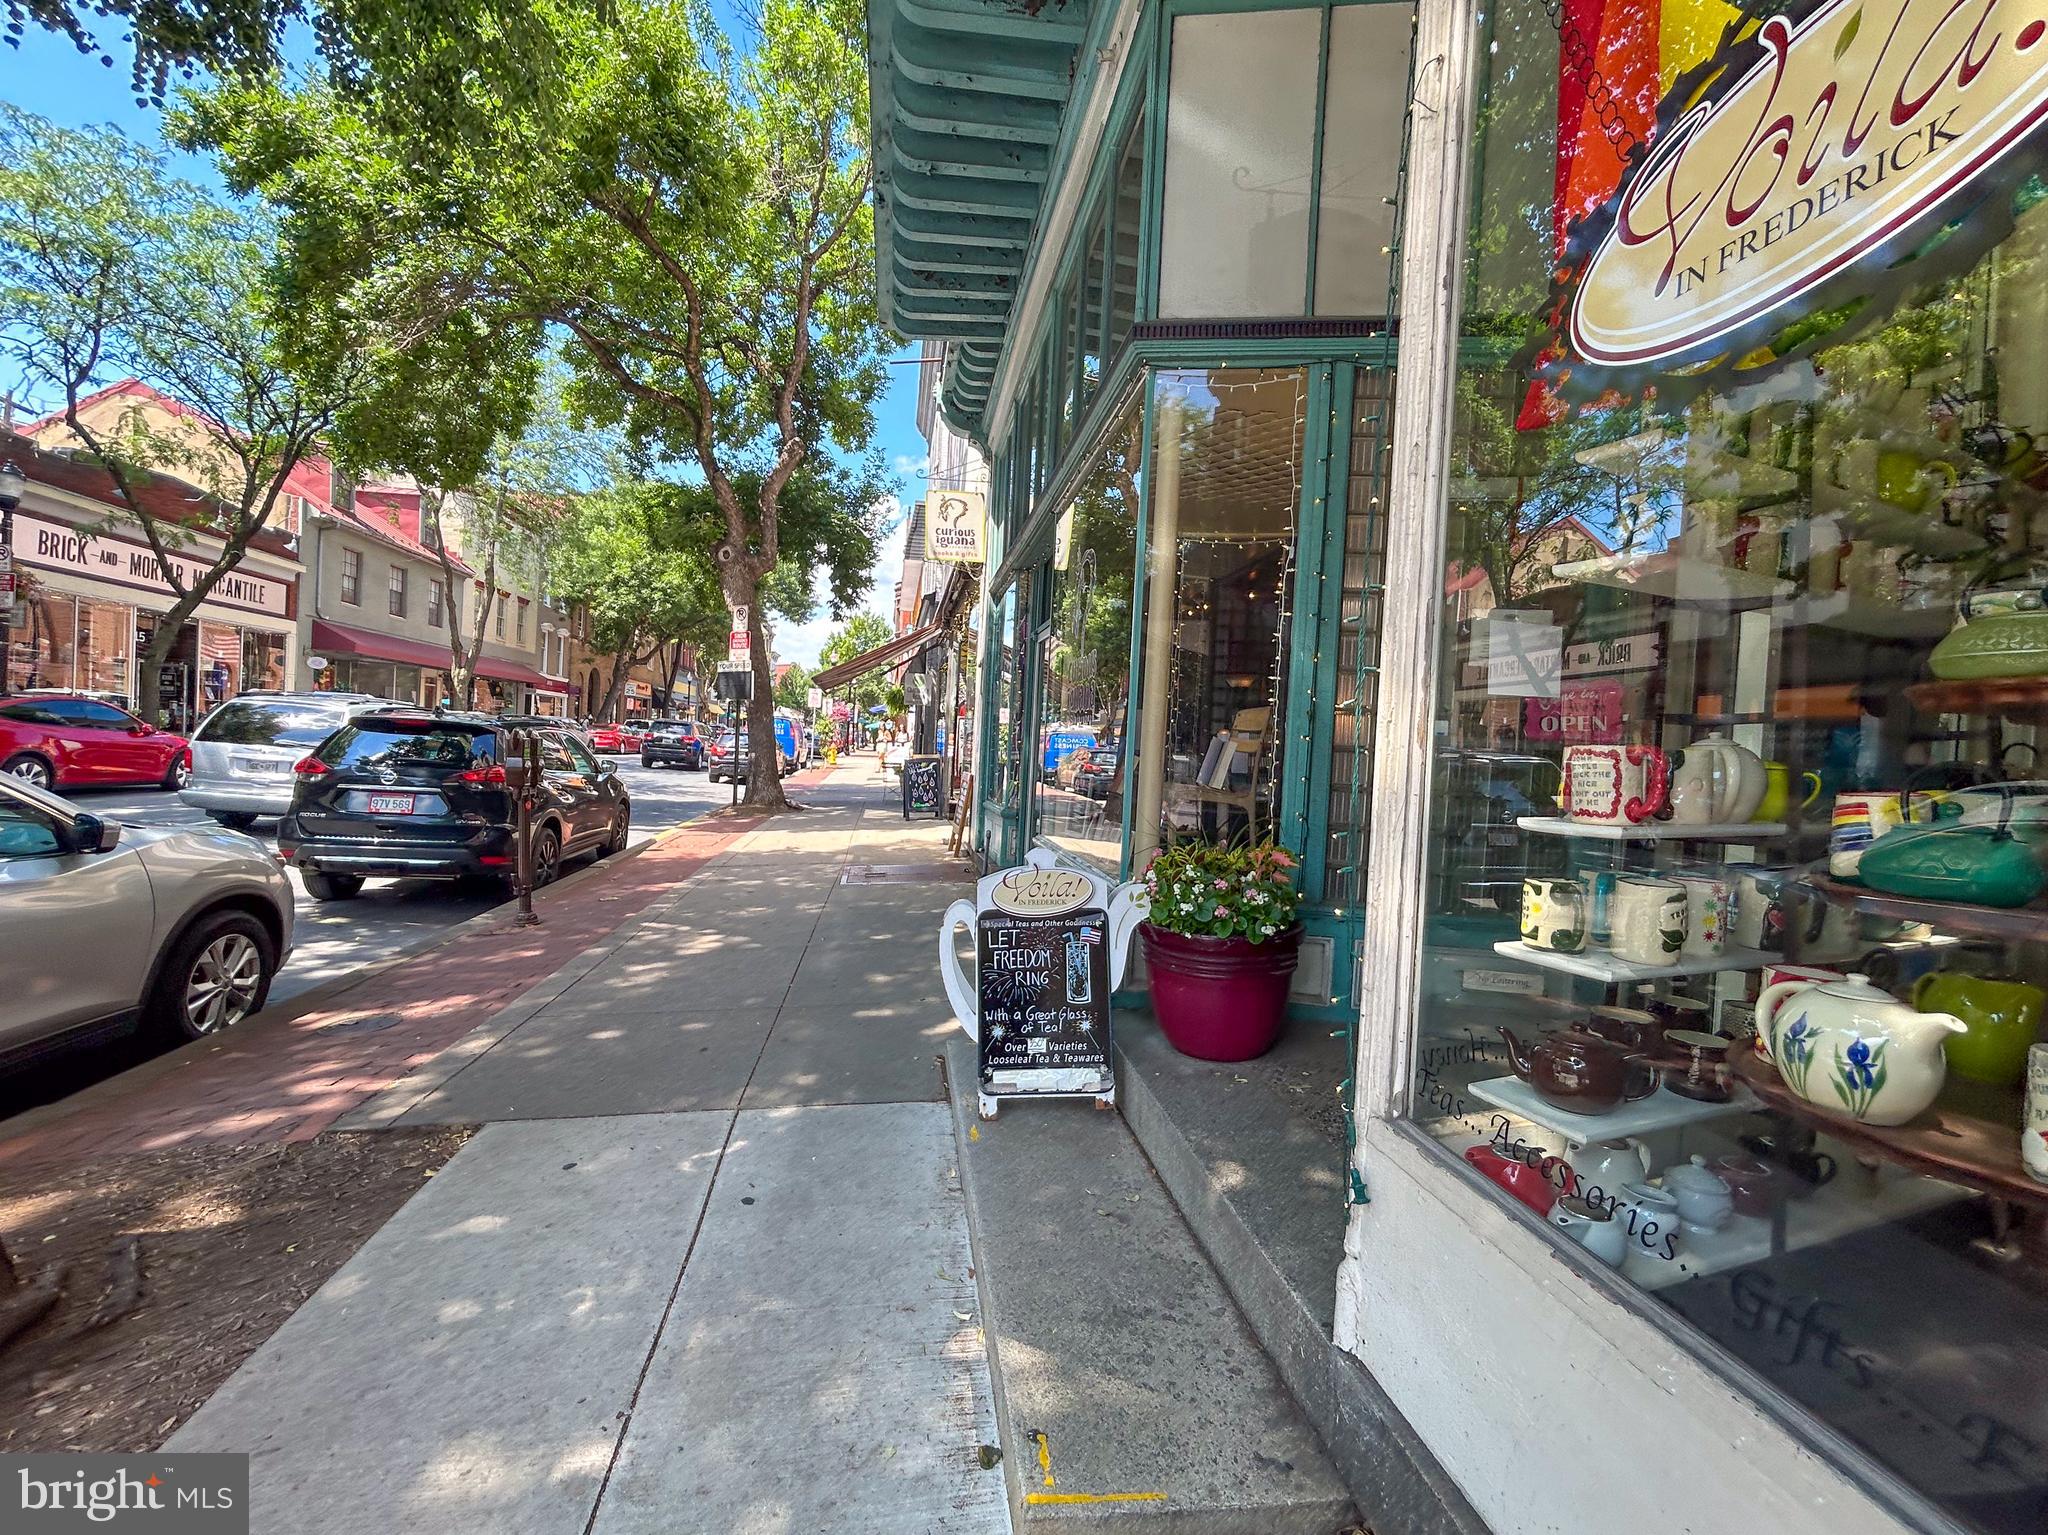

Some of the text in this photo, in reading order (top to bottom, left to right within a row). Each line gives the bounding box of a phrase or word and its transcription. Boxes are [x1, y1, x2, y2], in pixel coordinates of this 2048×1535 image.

[1674, 103, 1963, 299] IN FREDERICK
[935, 527, 975, 537] curious
[37, 528, 89, 566] BRICK
[99, 552, 119, 567] AND
[936, 535, 975, 548] iguana
[1541, 714, 1608, 732] OPEN
[990, 920, 1014, 929] Special
[1015, 920, 1030, 928] Teas
[1044, 919, 1064, 928] Other
[987, 929, 1021, 949] LET
[993, 948, 1052, 970] FREEDOM
[1014, 970, 1050, 987] RING
[1013, 1012, 1021, 1020] a
[1025, 1005, 1057, 1021] Great
[1020, 1019, 1064, 1034] of Tea!
[1004, 1042, 1027, 1052] Over
[1048, 1041, 1088, 1051] Varieties
[988, 1053, 1105, 1065] Looseleaf Tea & Teawares
